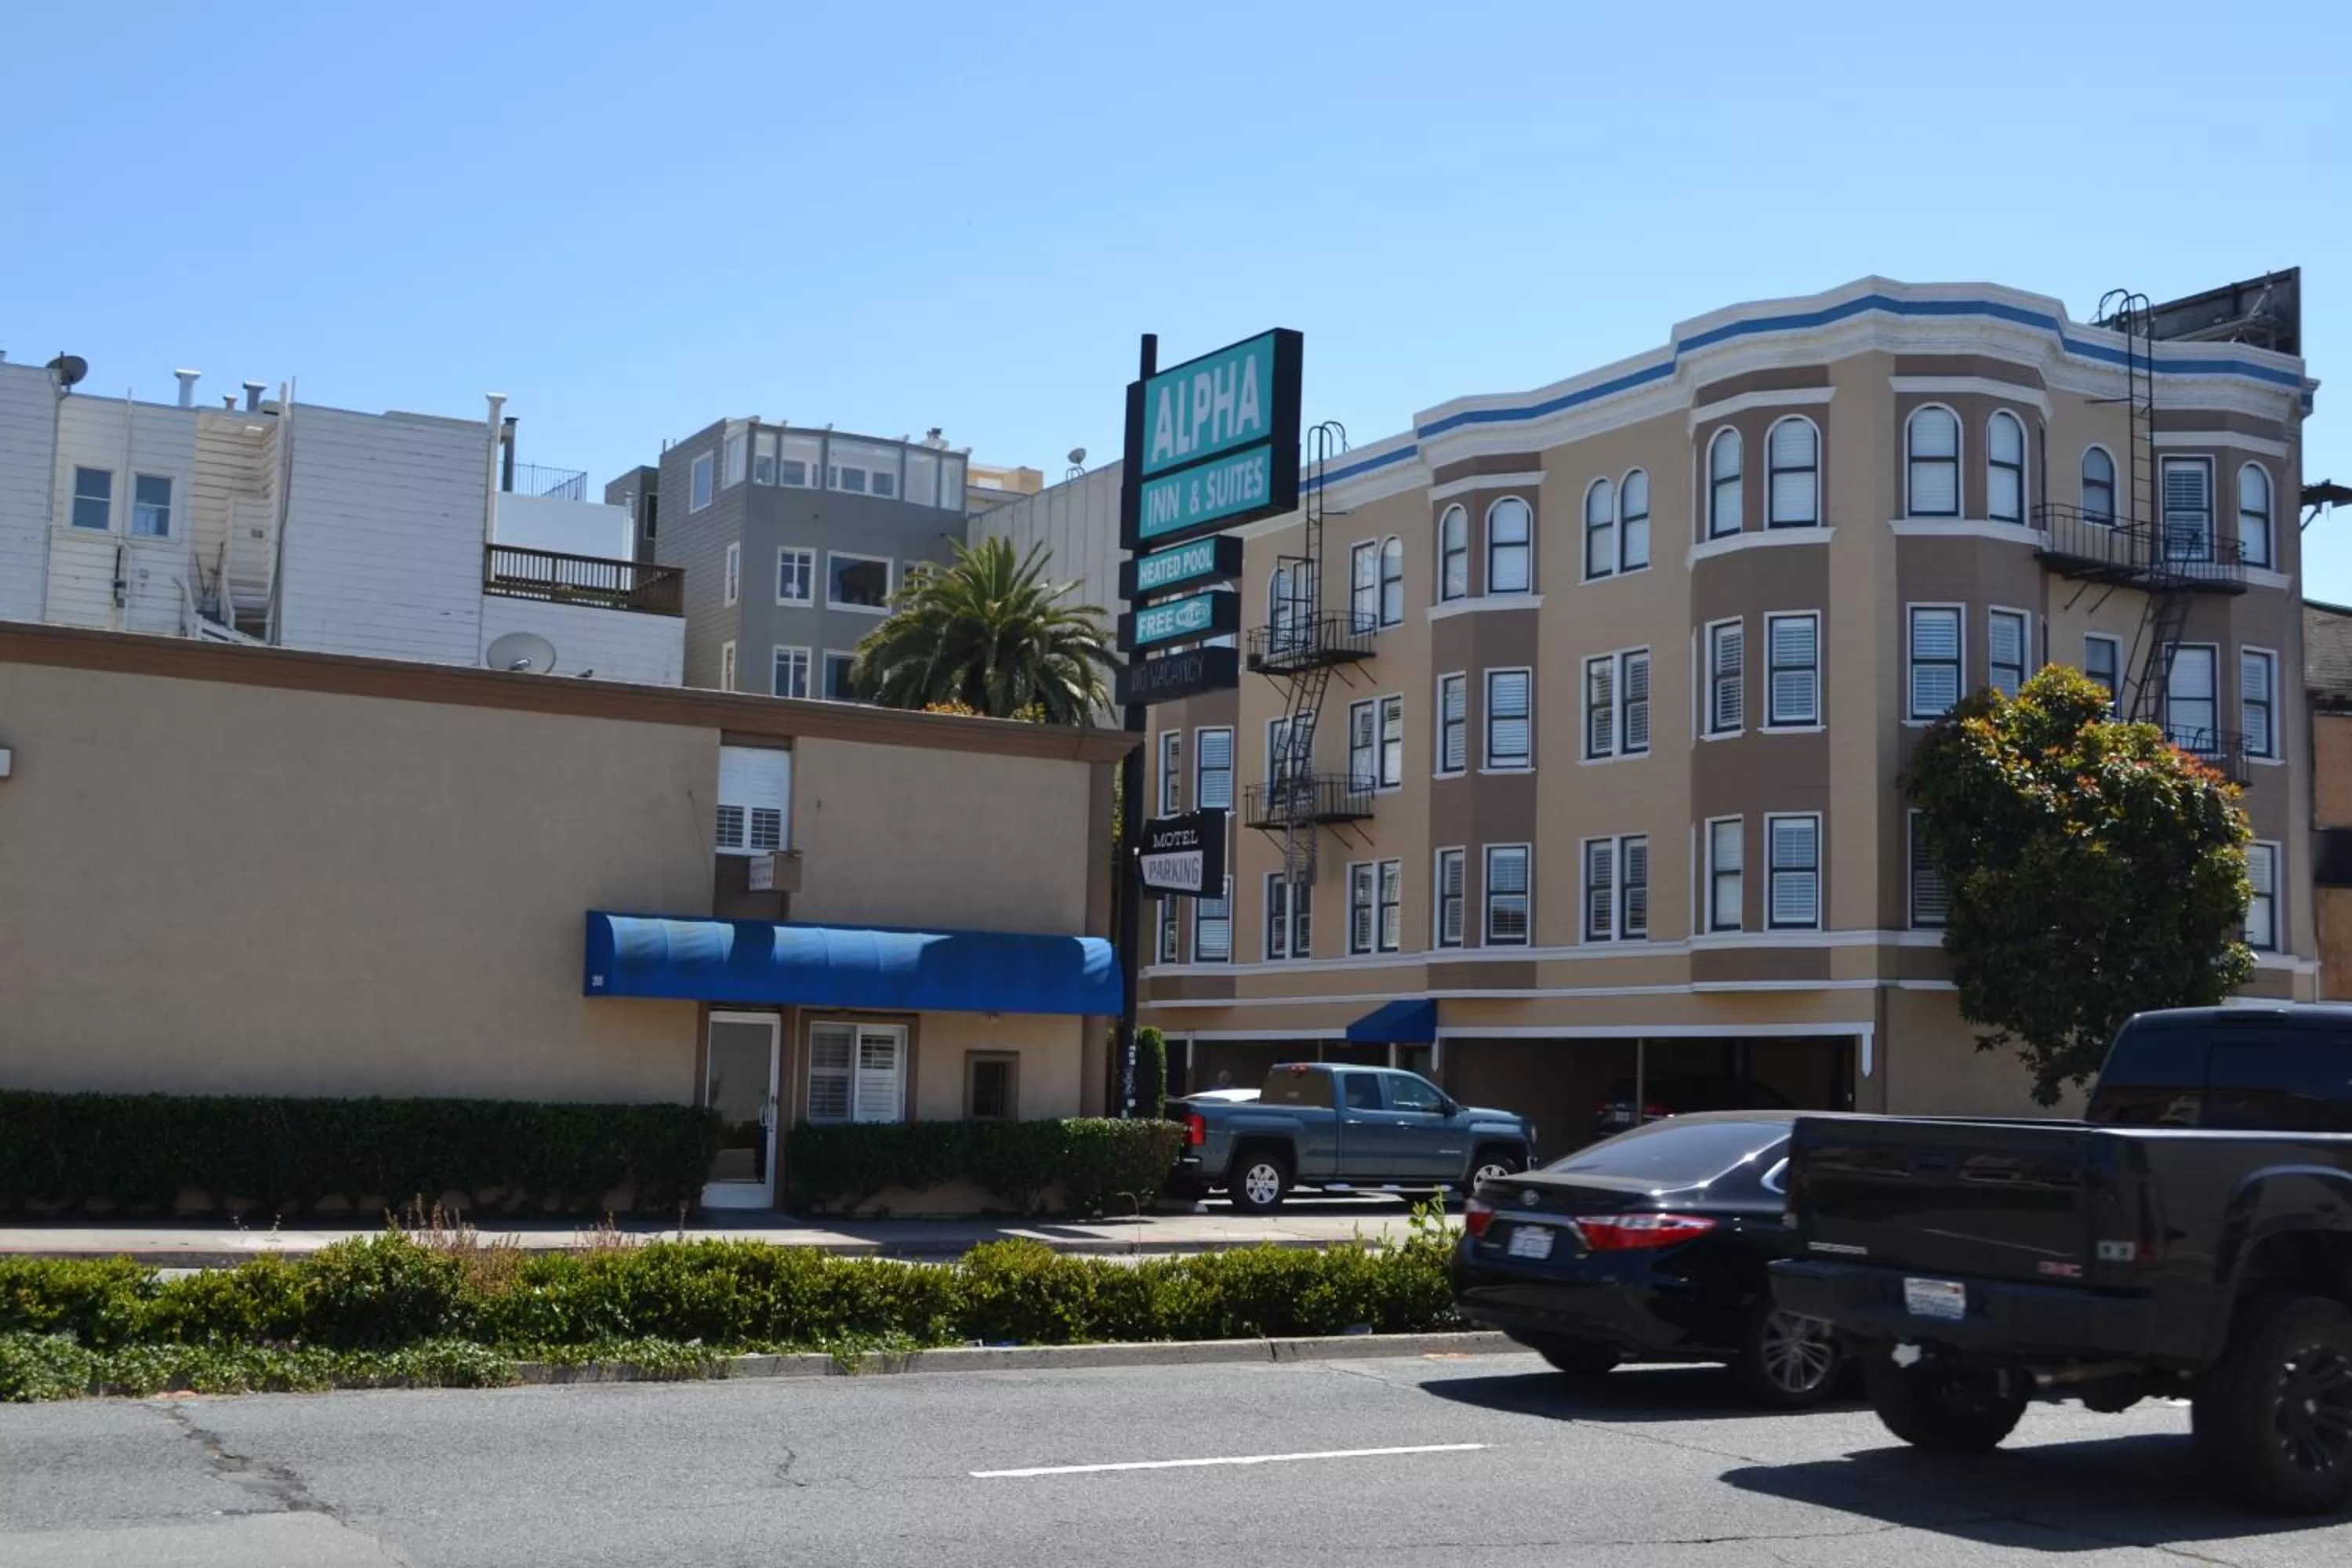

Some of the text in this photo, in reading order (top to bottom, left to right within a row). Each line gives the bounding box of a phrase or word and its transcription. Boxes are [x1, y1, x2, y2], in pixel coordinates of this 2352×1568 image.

[1151, 354, 1261, 463] ALPHA
[1148, 456, 1265, 528] INN & SUITES
[1140, 546, 1213, 584] HEATED POOL
[1138, 608, 1175, 639] FREE
[1150, 655, 1205, 688] VACANCY
[1153, 829, 1199, 848] MOTEL
[1149, 857, 1199, 886] PARKING
